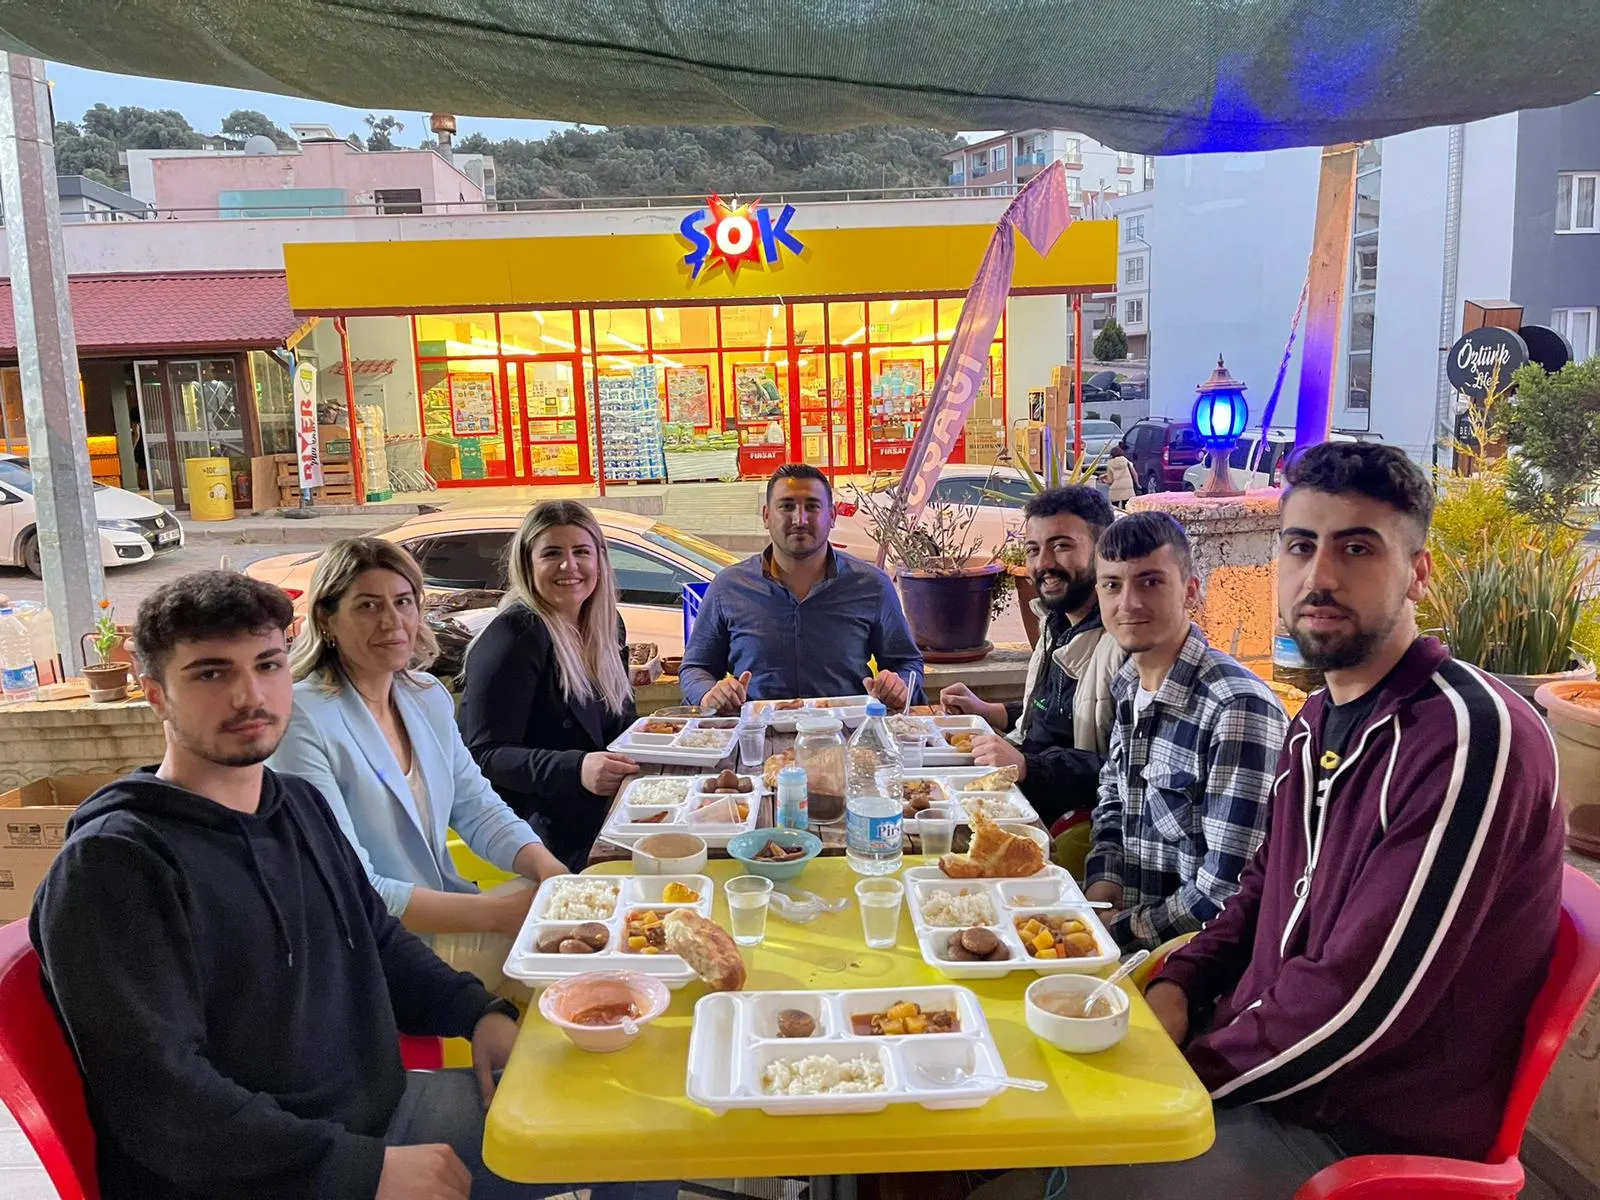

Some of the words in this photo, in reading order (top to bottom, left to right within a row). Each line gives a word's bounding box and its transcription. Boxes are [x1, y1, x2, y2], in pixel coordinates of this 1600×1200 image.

[680, 203, 805, 280] ŞOK
[1457, 338, 1510, 374] Öztürk
[880, 447, 906, 455] FIRSAT
